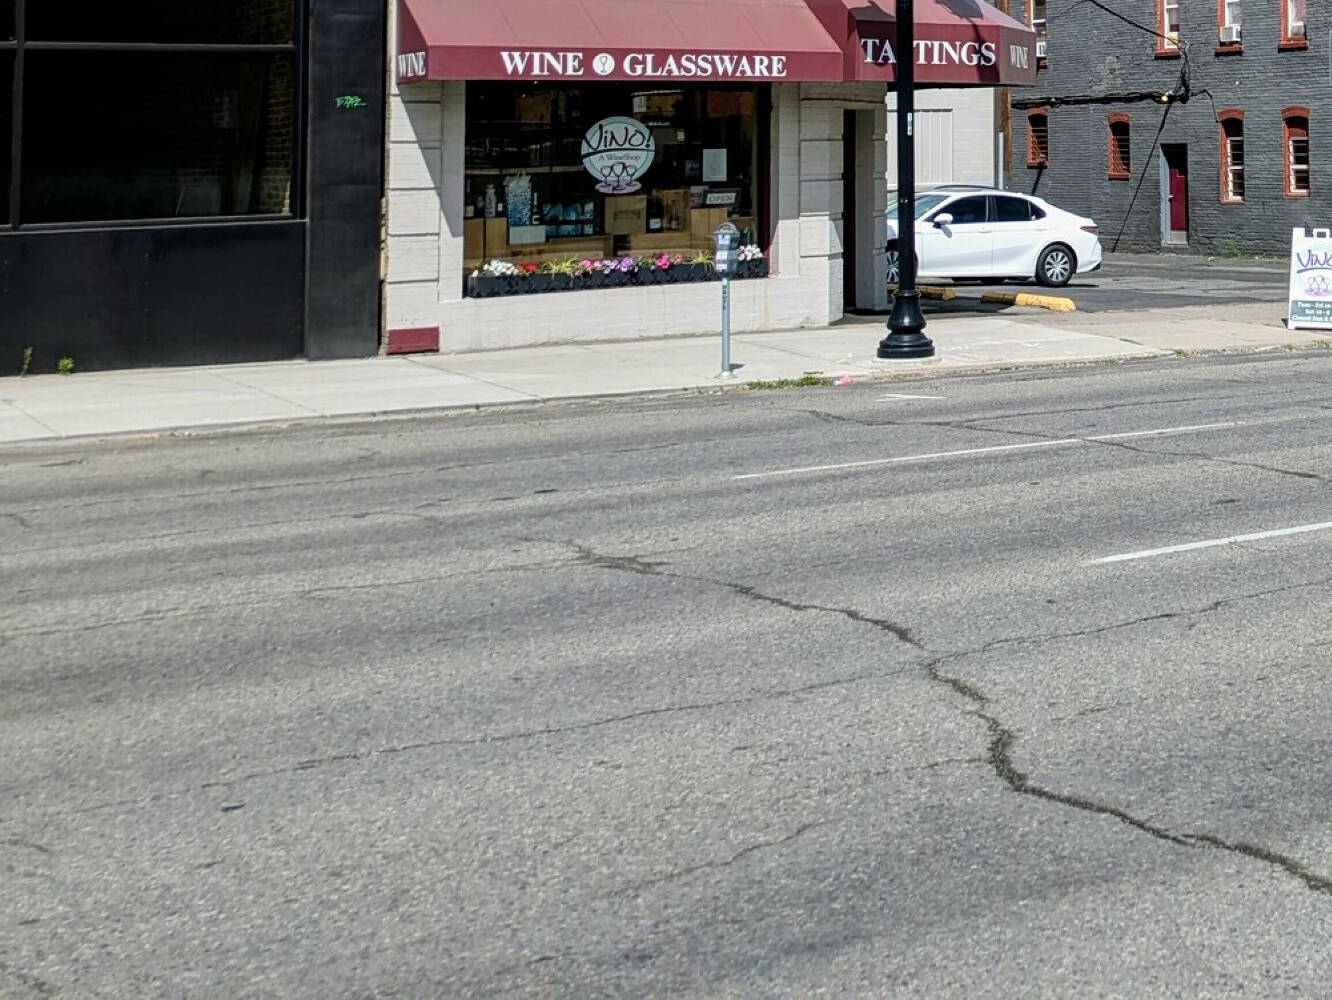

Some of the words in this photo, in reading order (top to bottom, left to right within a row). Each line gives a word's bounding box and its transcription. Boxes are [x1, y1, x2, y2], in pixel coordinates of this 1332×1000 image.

[397, 51, 427, 78] WINE
[500, 51, 585, 77] WINE
[622, 54, 788, 78] GLASSWARE
[861, 38, 997, 66] TATINGS
[709, 193, 735, 202] OPEN
